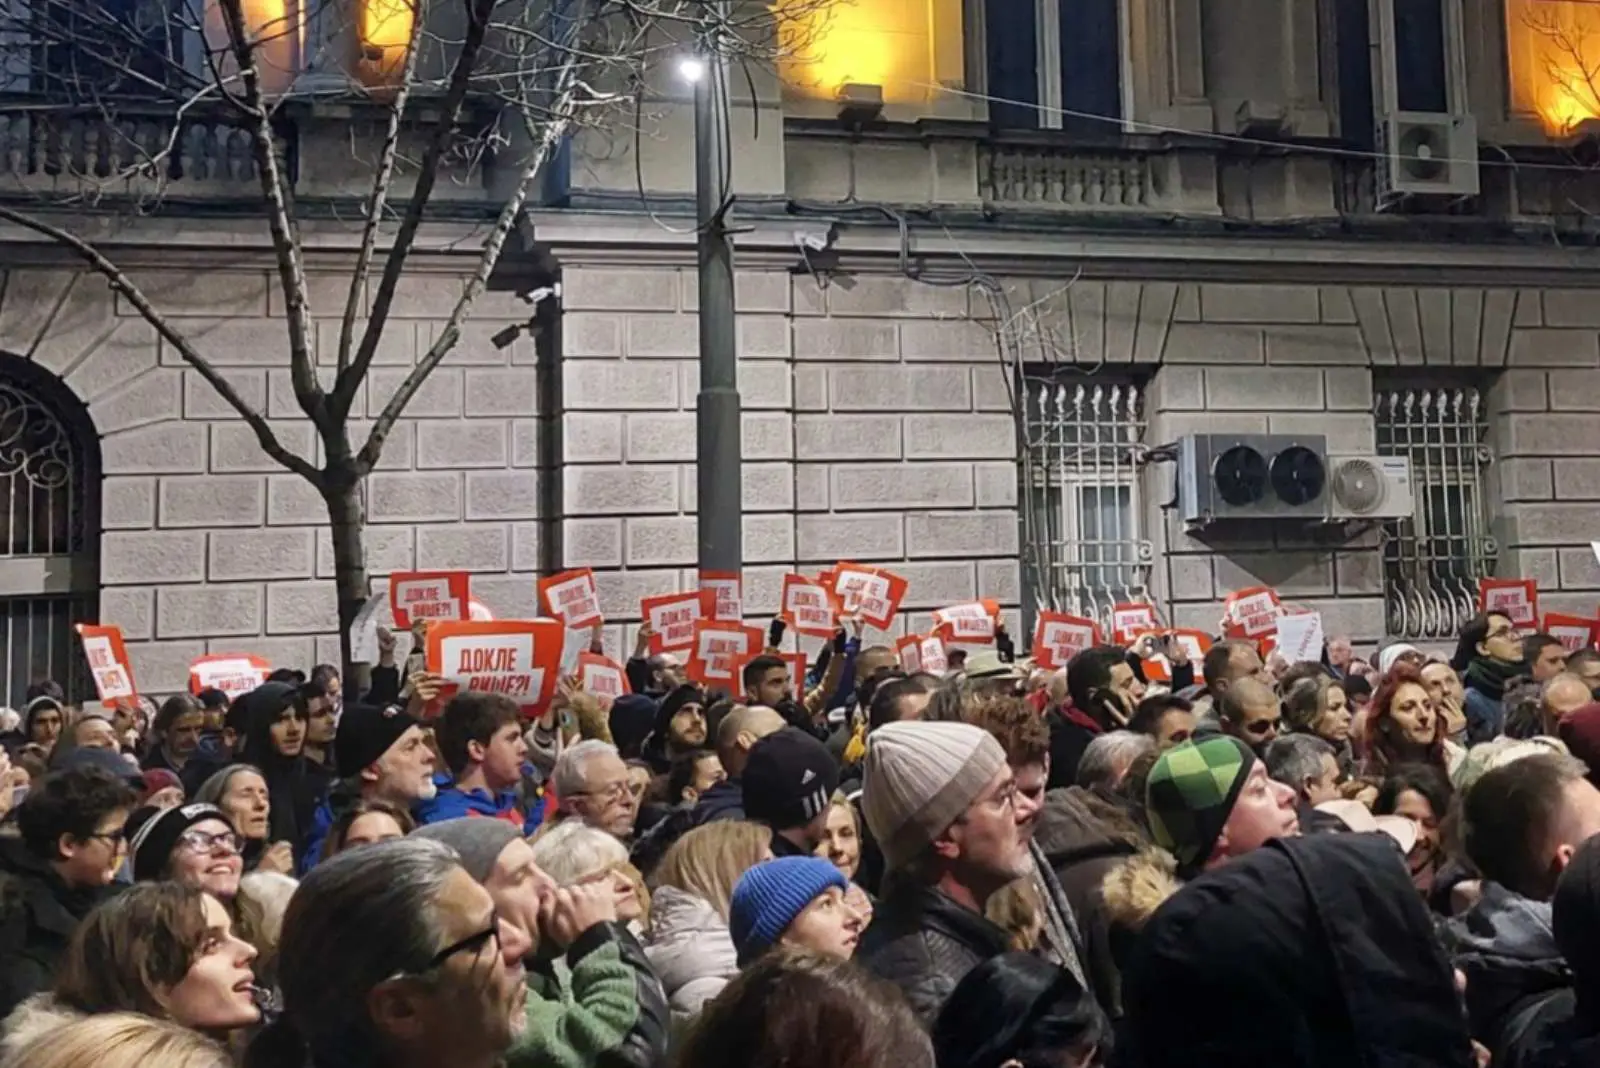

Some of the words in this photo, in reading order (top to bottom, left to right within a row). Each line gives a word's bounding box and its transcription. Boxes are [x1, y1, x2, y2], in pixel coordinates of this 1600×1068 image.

[404, 587, 439, 602] ДОКЛЕ
[412, 602, 452, 617] ВИШЕ?!
[457, 647, 518, 674] ДОКЛЕ
[468, 675, 532, 697] ВИШЕ?!
